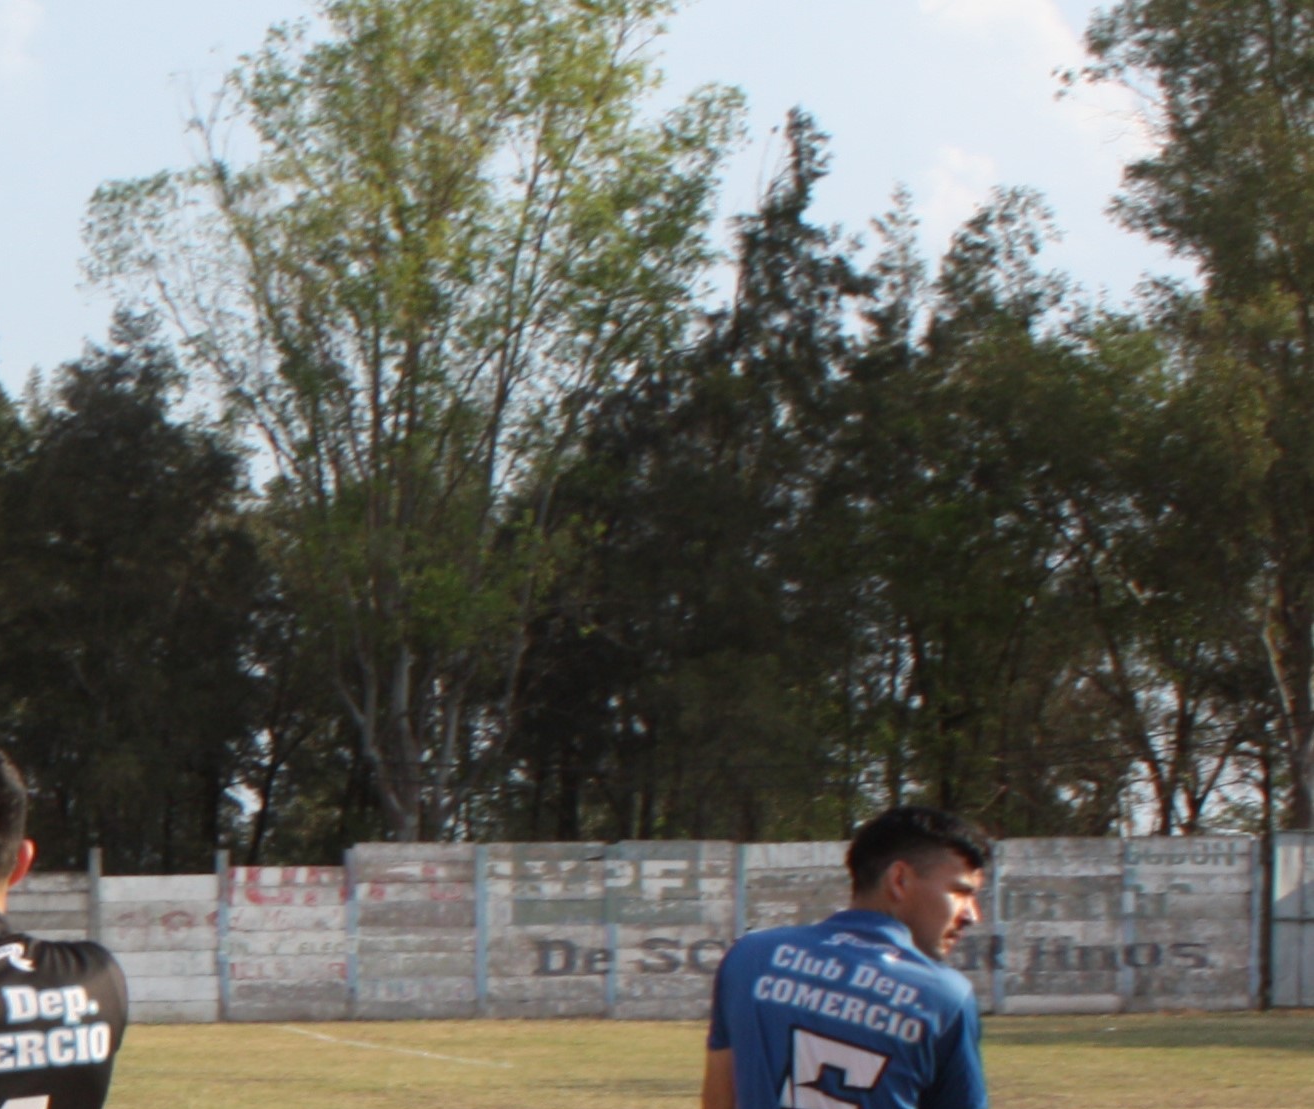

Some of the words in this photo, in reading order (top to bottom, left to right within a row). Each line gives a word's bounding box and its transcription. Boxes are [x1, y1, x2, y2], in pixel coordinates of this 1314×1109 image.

[5, 984, 100, 1023] Dep.
[753, 974, 923, 1044] COMERCIO
[771, 943, 844, 981] Club
[848, 962, 922, 1010] Dep.
